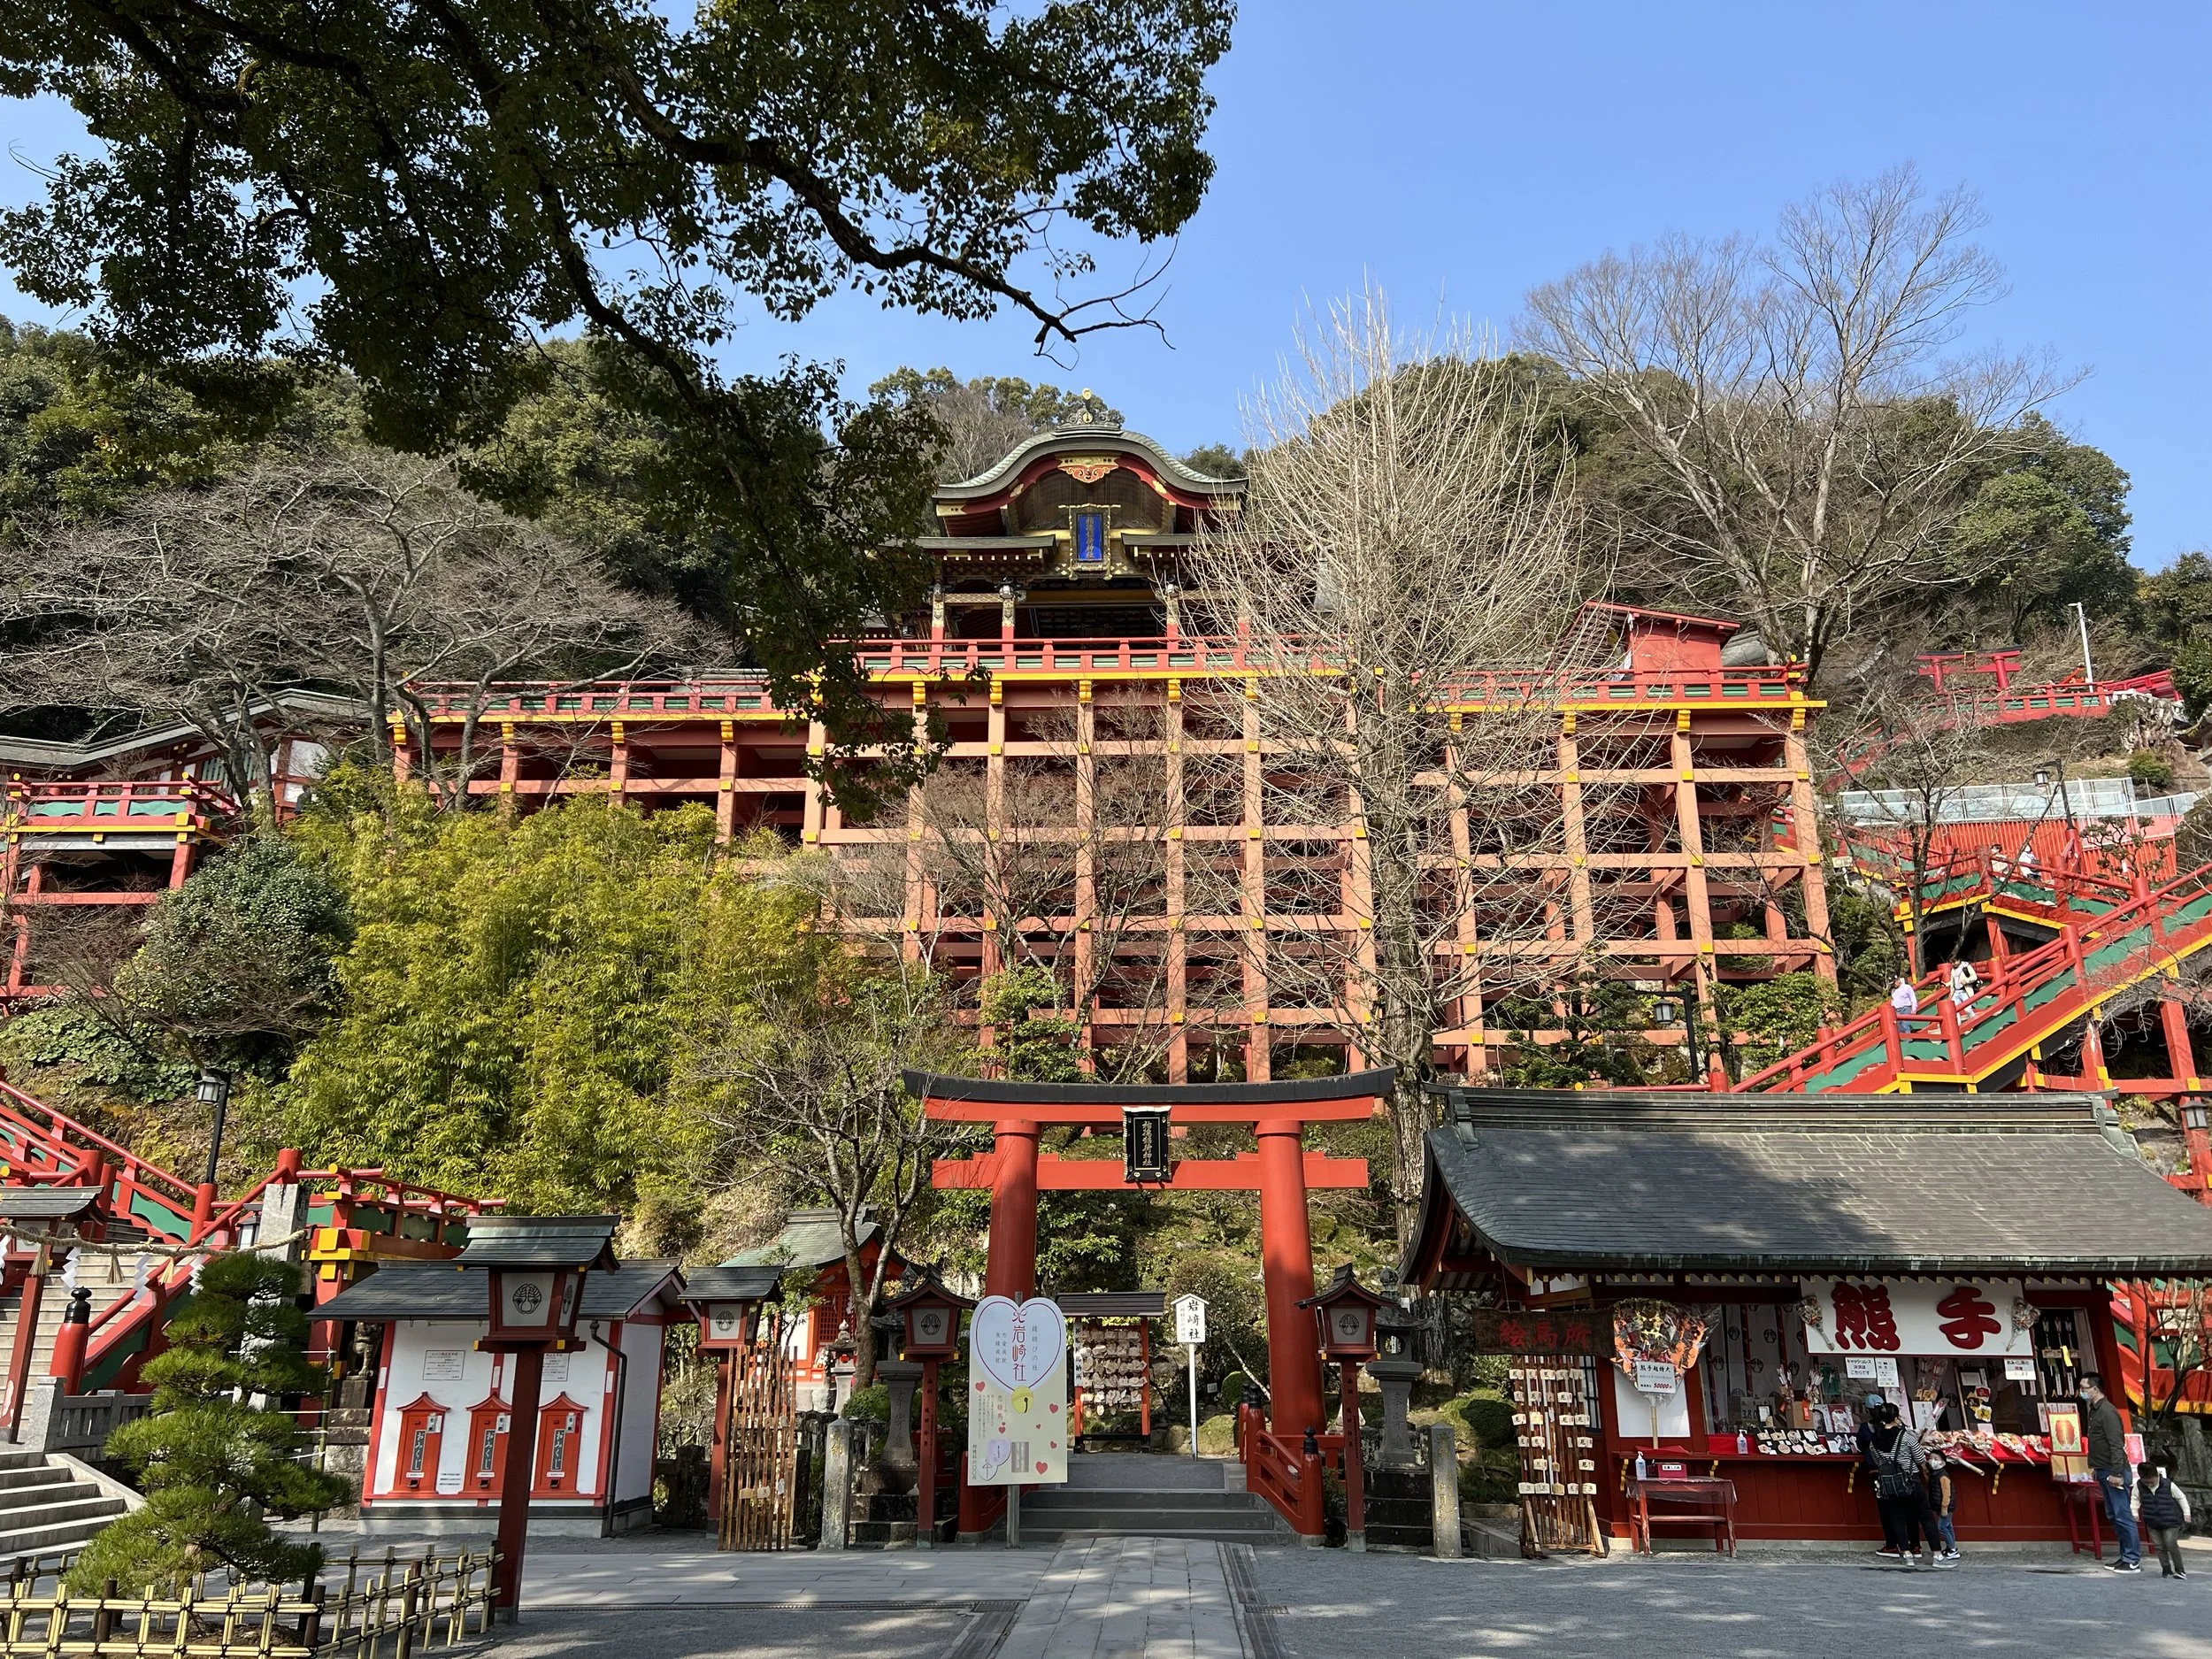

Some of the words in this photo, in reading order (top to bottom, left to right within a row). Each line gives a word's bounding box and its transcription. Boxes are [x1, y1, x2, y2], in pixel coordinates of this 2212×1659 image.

[1831, 1281, 2002, 1352] 熊手
[415, 1432, 425, 1470] おみくじ
[485, 1431, 495, 1470] おみくじ
[554, 1431, 564, 1470] おみくじ
